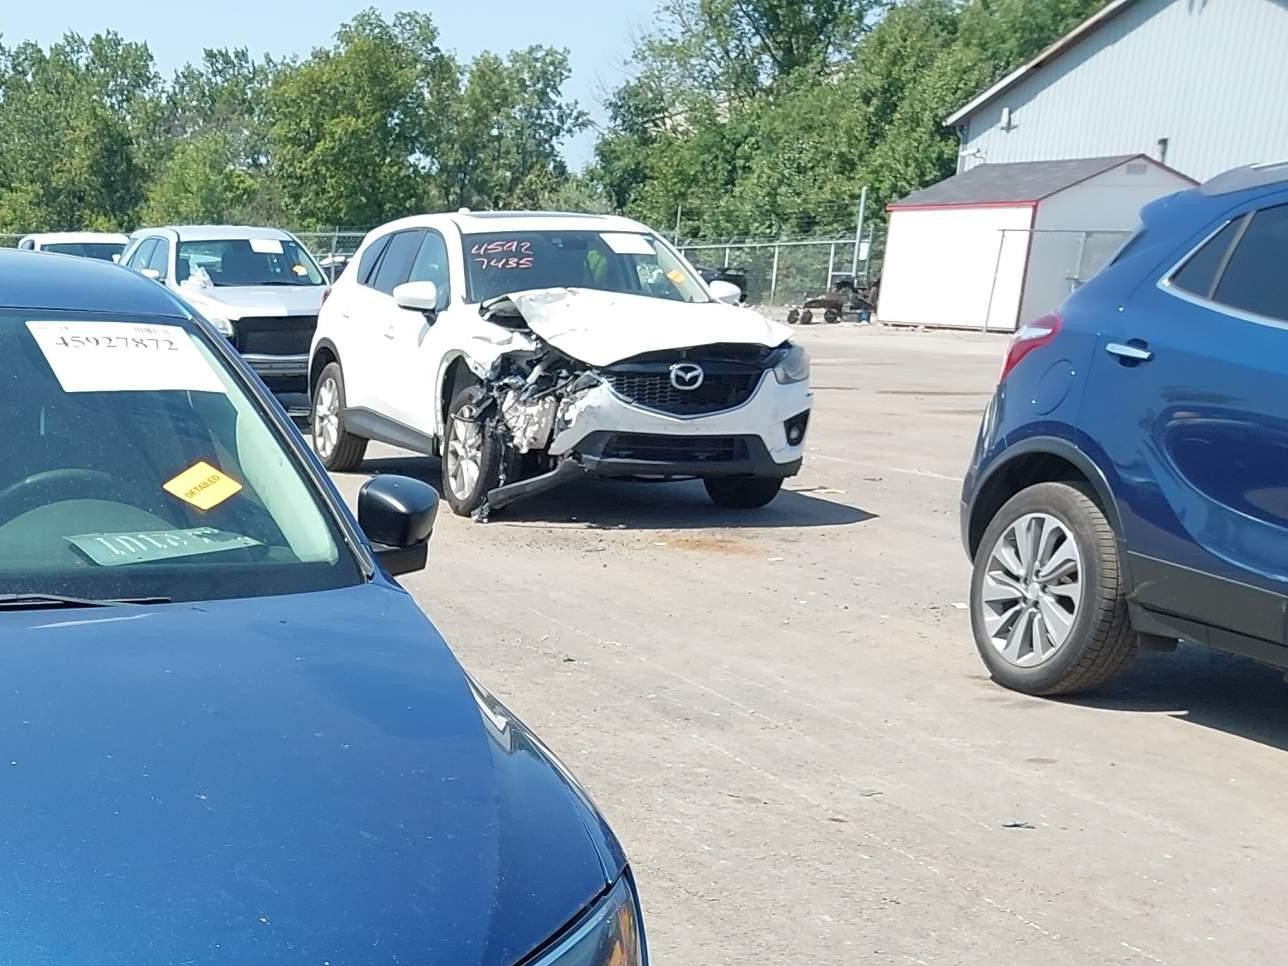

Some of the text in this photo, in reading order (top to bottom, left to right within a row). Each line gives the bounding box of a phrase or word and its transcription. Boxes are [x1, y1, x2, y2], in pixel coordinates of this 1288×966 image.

[471, 241, 534, 255] 4592
[474, 257, 534, 269] 7435
[56, 336, 179, 352] 45927872
